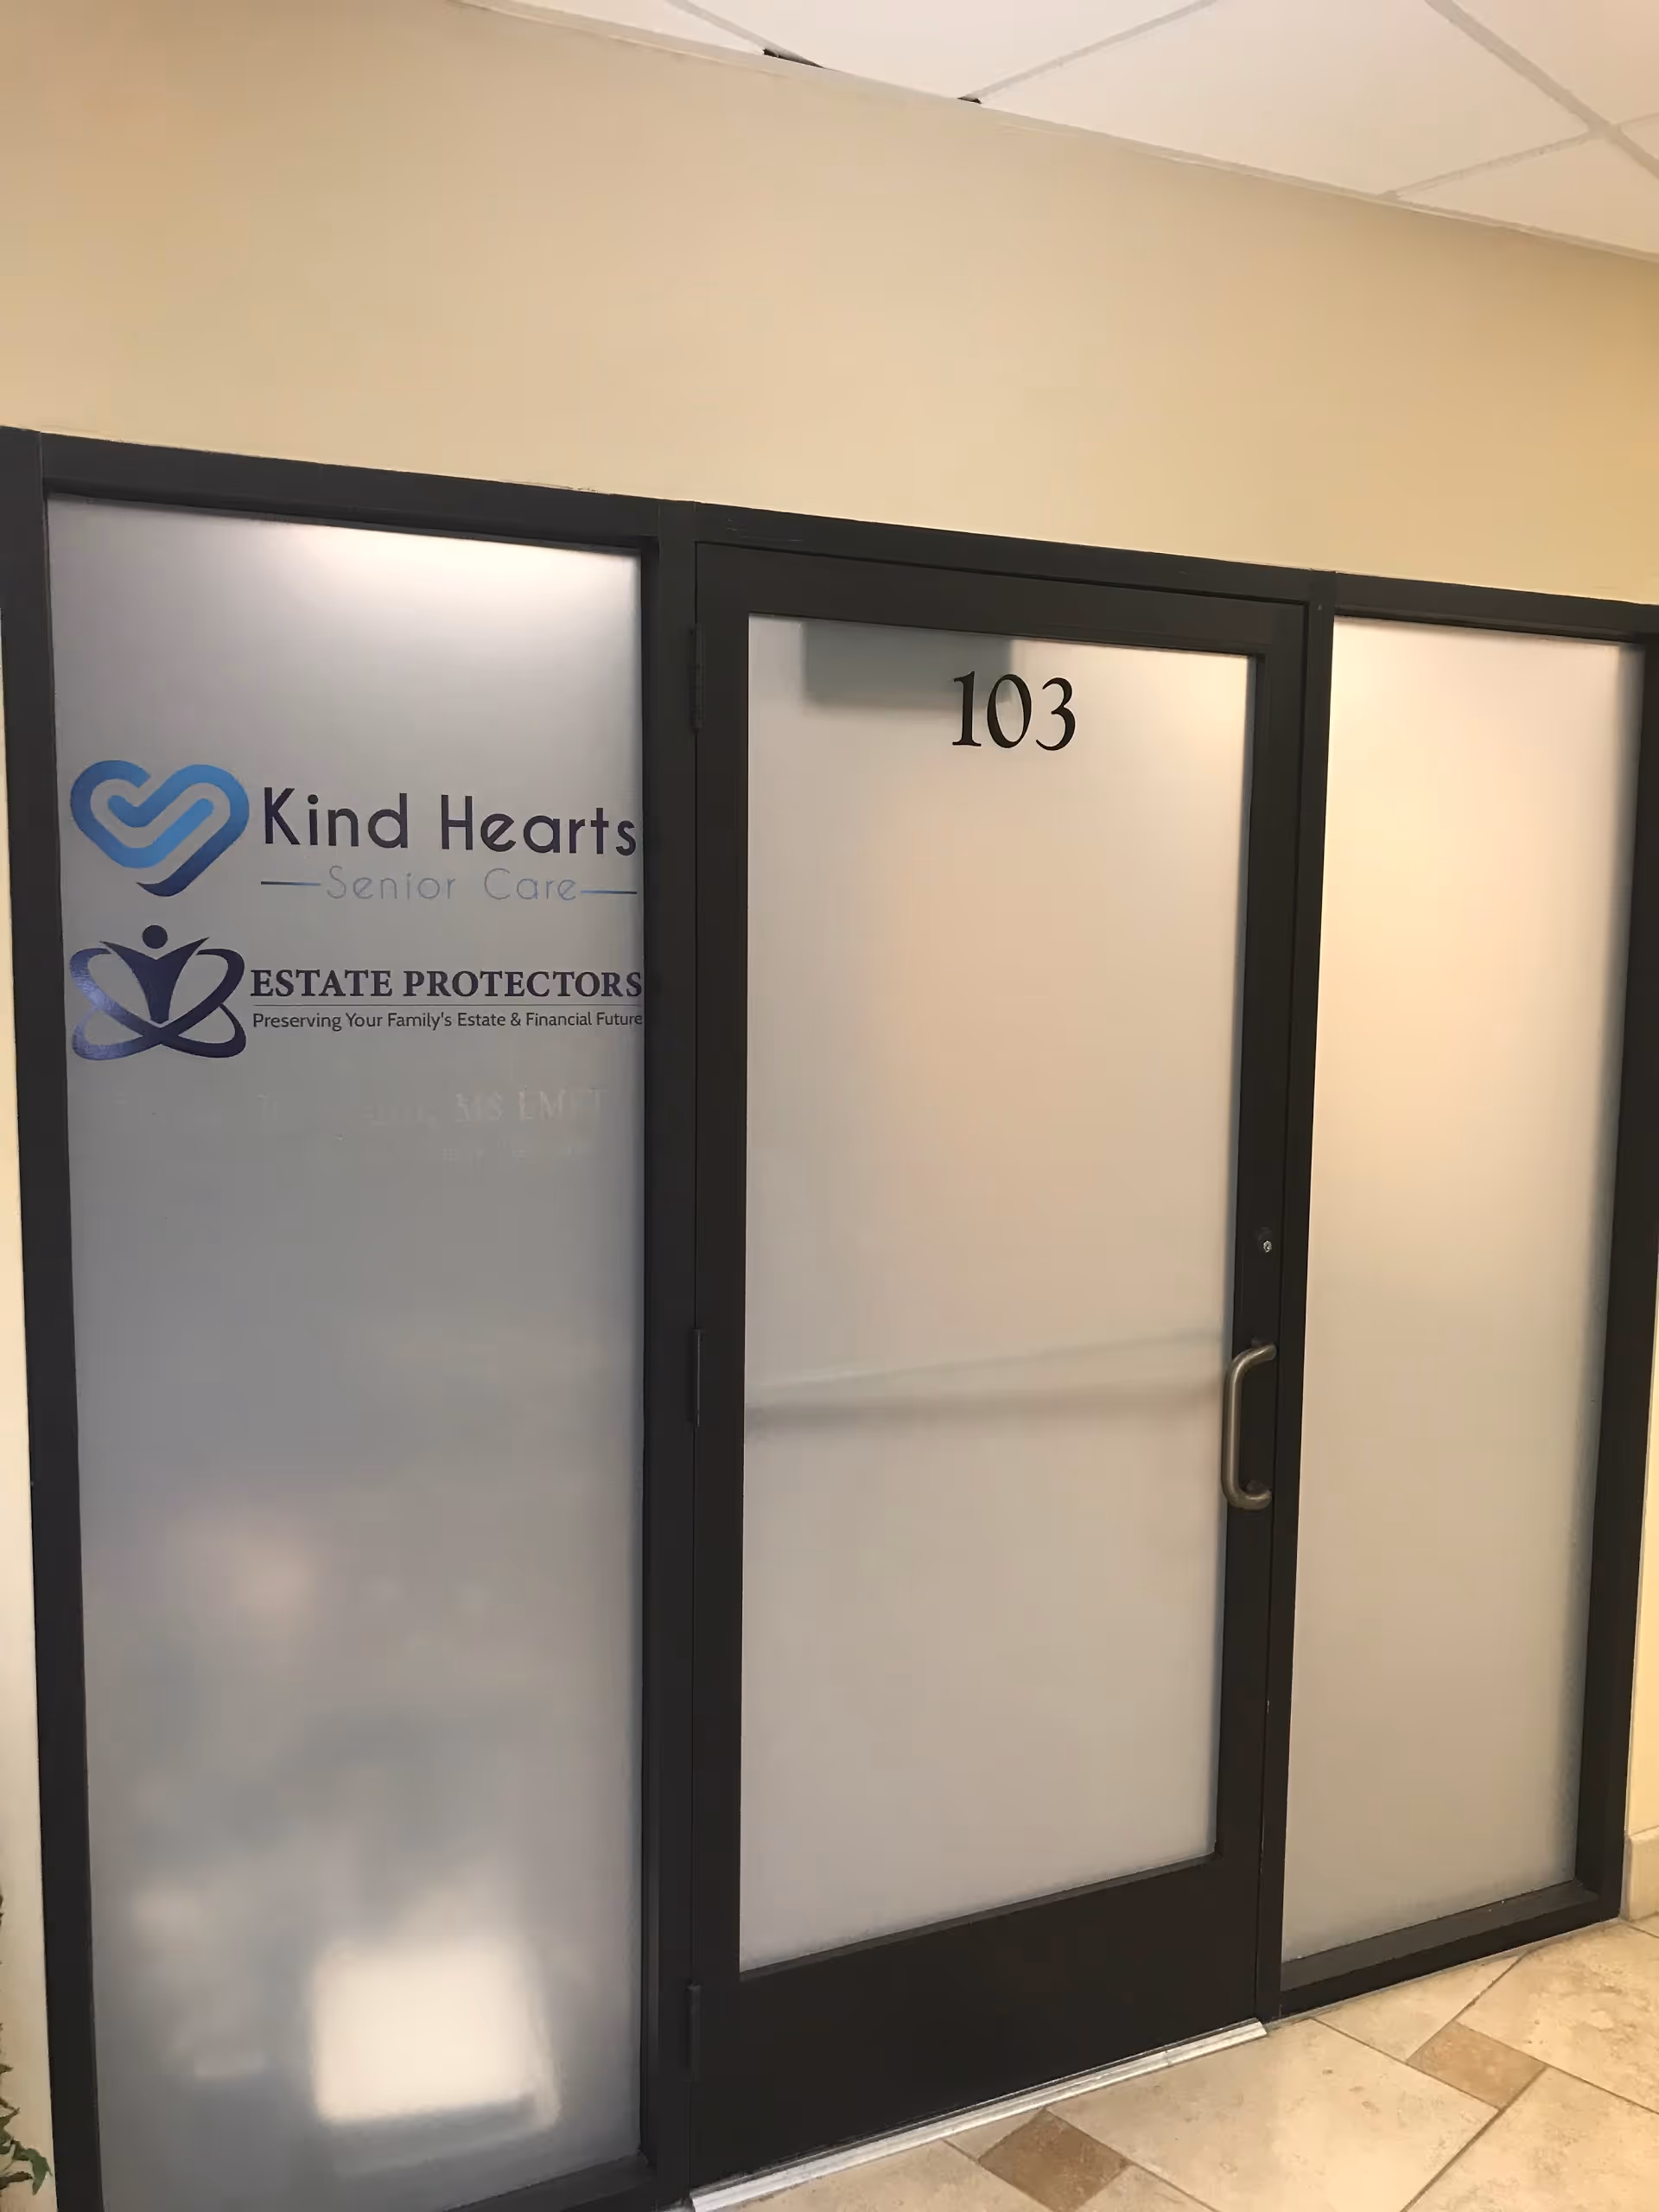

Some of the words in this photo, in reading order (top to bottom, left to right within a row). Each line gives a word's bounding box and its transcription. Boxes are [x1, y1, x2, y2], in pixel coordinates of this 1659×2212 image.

[952, 671, 1076, 751] 103
[264, 786, 409, 849] Kind
[440, 793, 638, 856] Hearts
[326, 865, 456, 900] Senior
[483, 868, 578, 902] Care
[250, 969, 393, 997] ESTATE
[403, 969, 643, 997] PROTECTORS
[252, 1012, 343, 1033] Preserving
[345, 1012, 384, 1027] Your
[387, 1011, 453, 1032] Family's
[457, 1012, 506, 1027] Estate
[510, 1012, 522, 1027] &
[525, 1011, 593, 1027] Financial
[596, 1011, 643, 1027] Future
